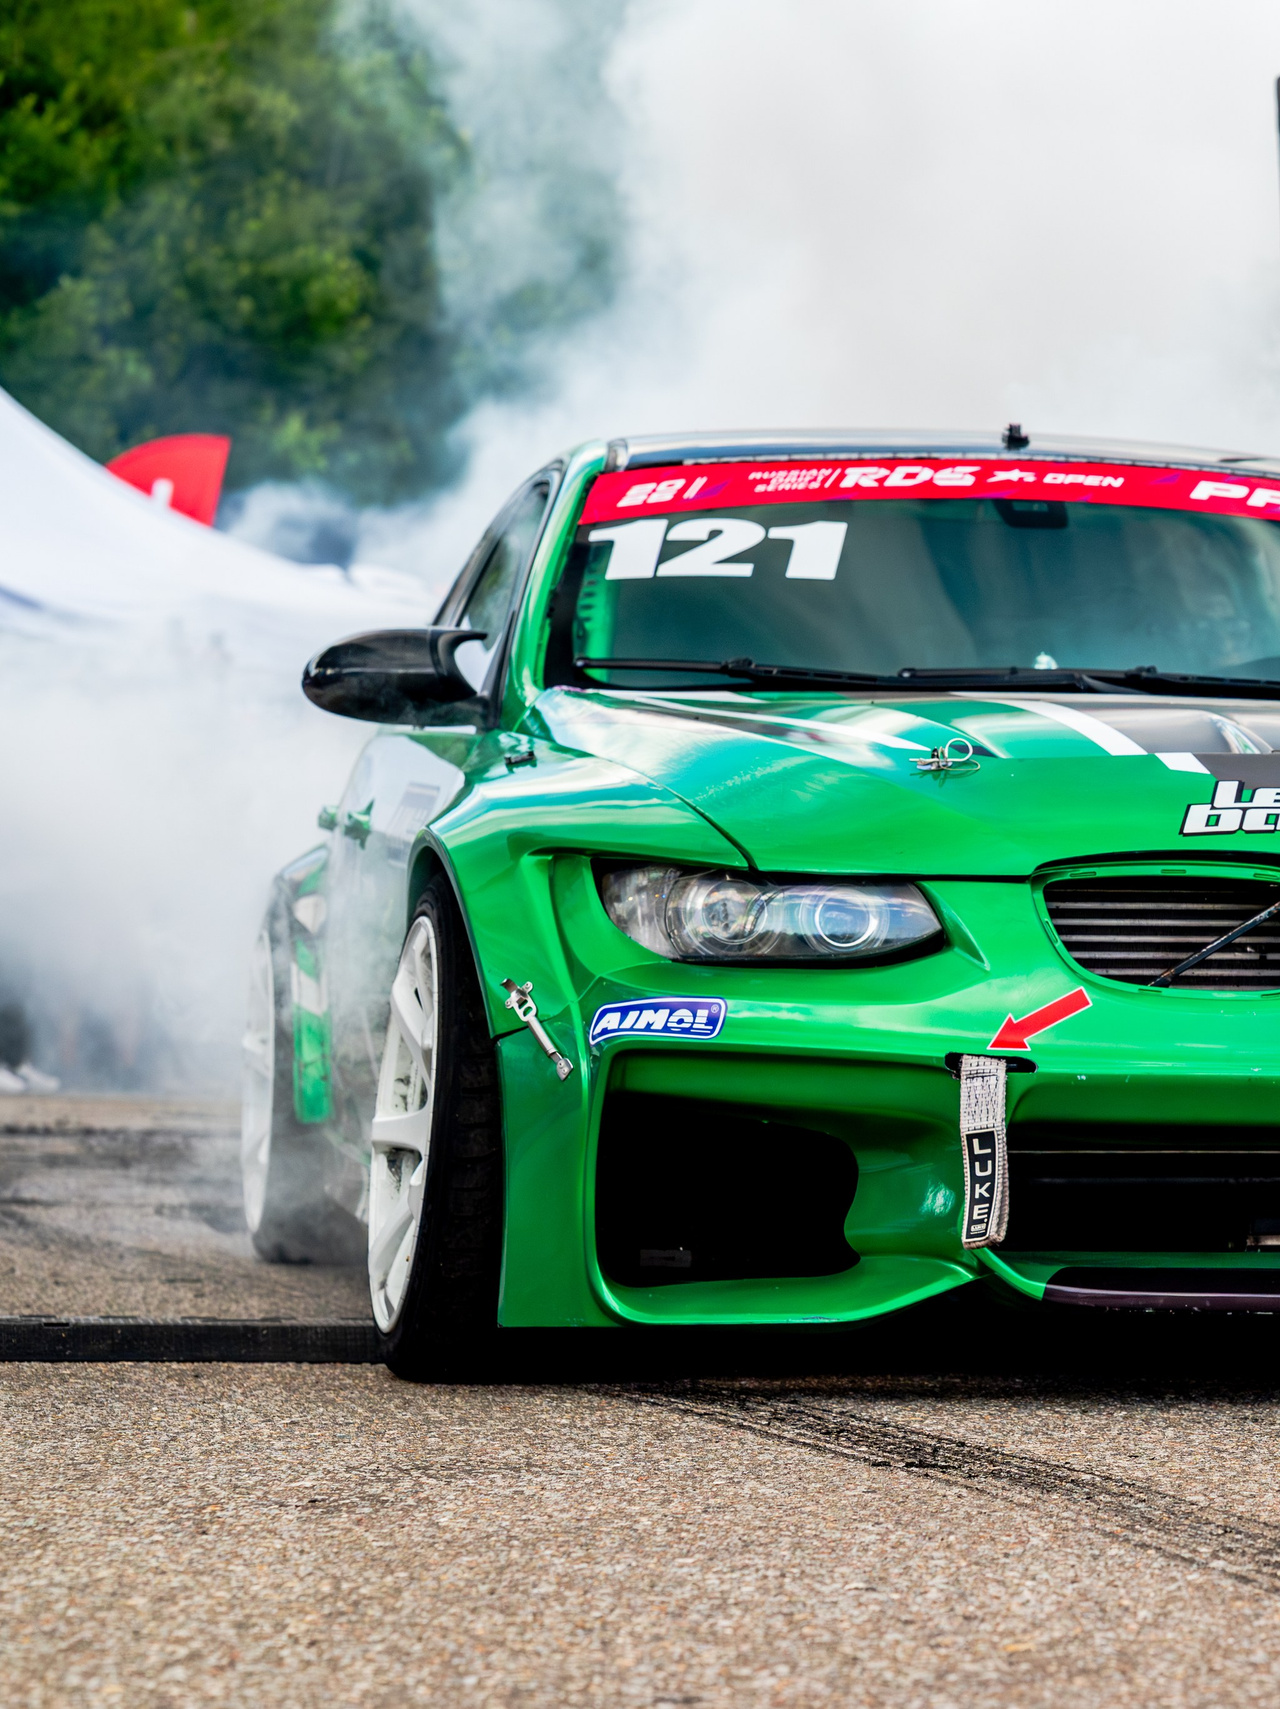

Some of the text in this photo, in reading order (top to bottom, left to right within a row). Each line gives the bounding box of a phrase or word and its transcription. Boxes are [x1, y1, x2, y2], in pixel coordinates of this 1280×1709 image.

[1043, 472, 1125, 488] OPEN
[588, 518, 848, 581] 121
[593, 1008, 714, 1035] AIMOL
[972, 1138, 992, 1220] LUKE
